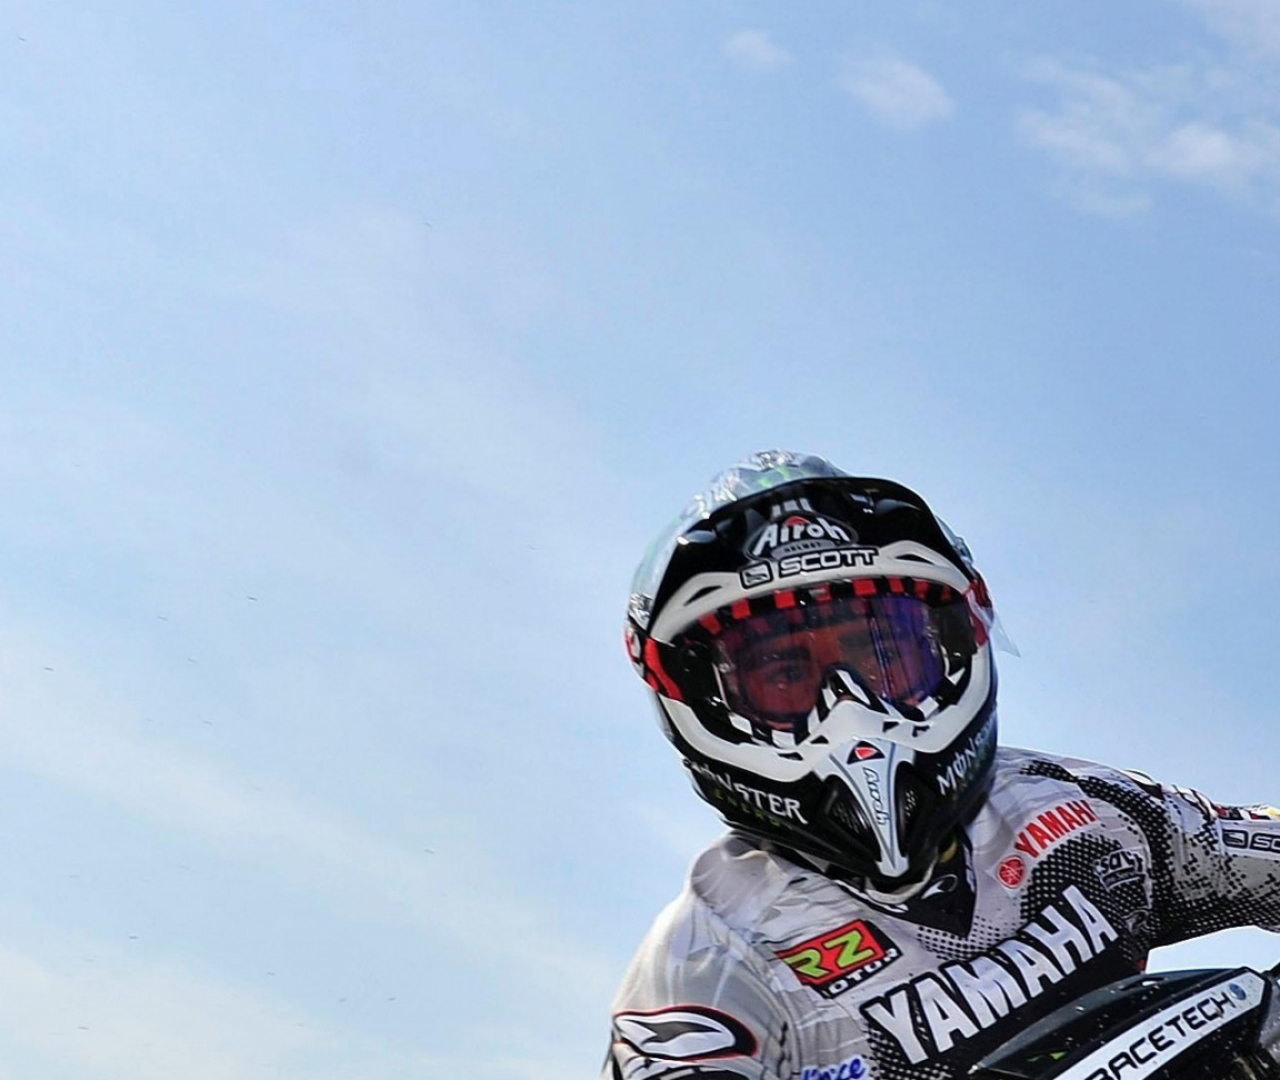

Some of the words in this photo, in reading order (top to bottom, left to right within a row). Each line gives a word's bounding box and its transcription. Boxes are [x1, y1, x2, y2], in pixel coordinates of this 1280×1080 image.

[752, 516, 851, 556] Airoh
[779, 547, 878, 578] SCOTT
[822, 947, 898, 996] OTO
[864, 884, 1119, 1064] YAMAHA
